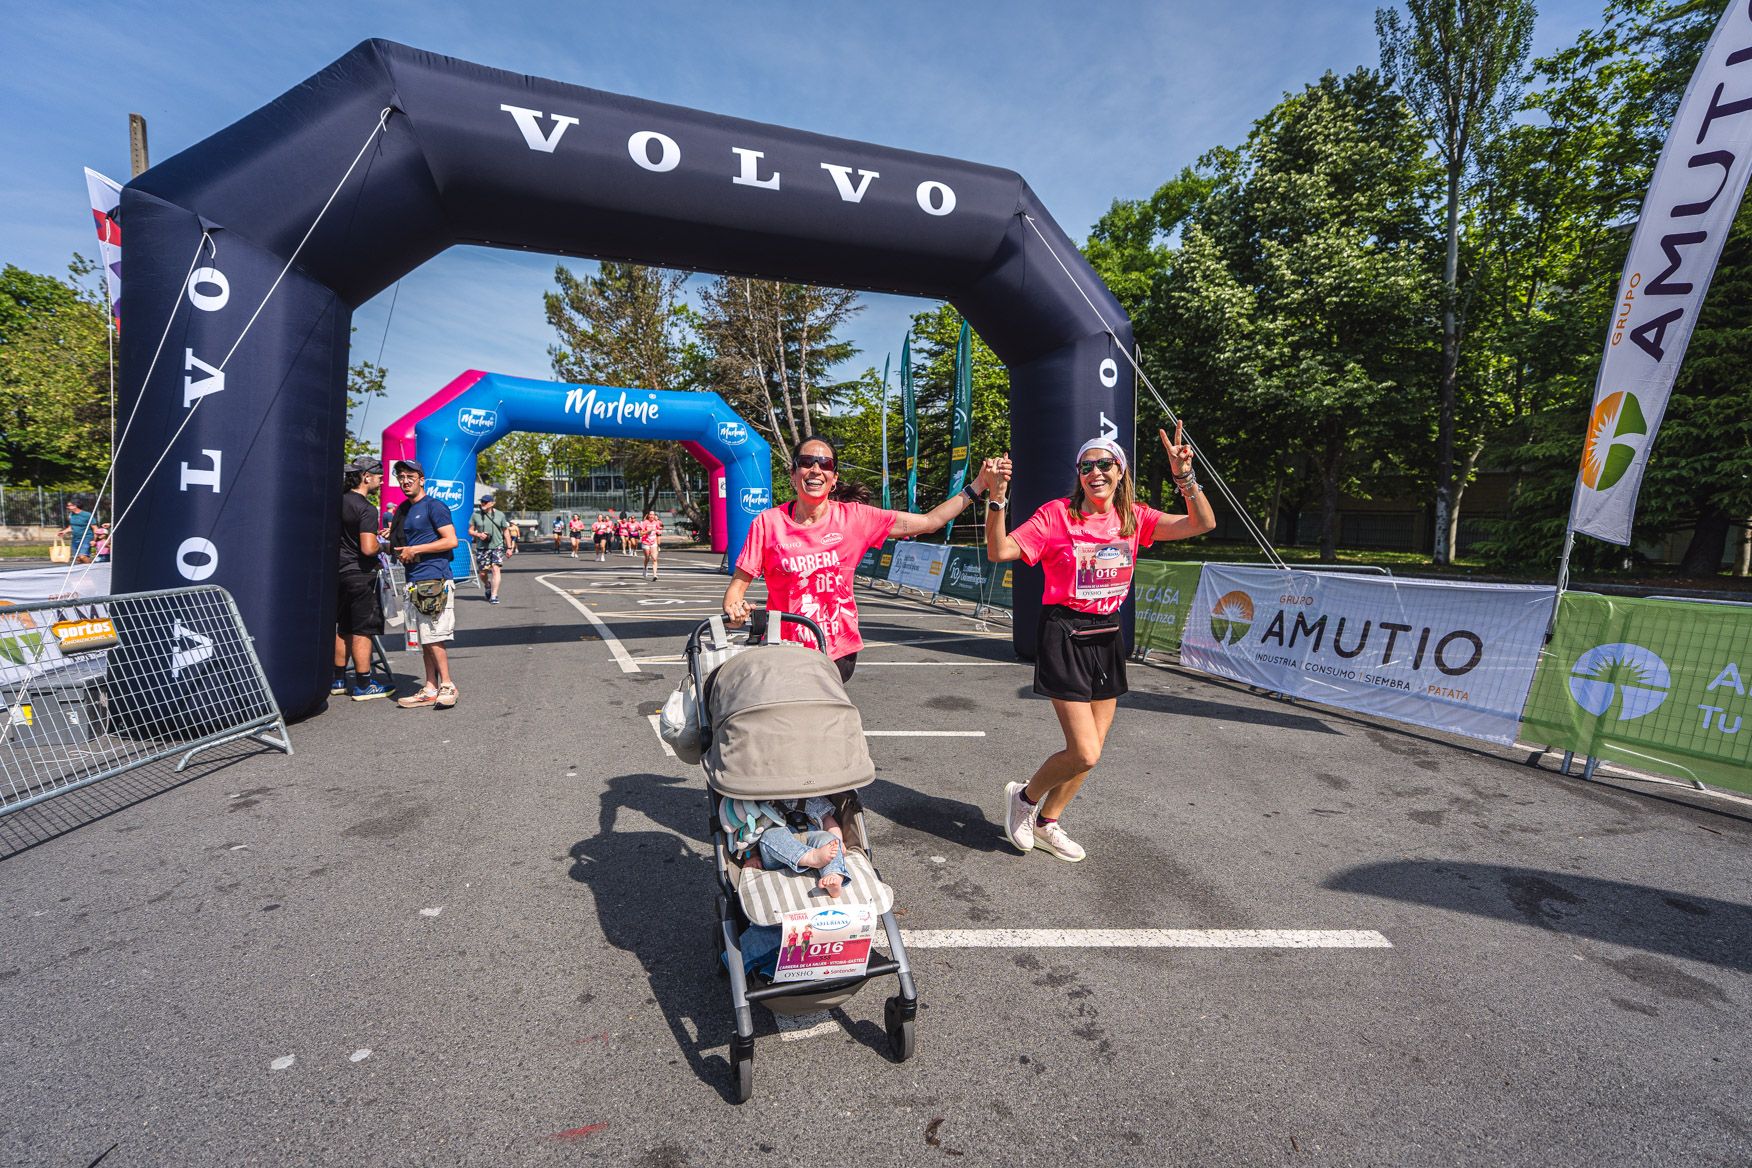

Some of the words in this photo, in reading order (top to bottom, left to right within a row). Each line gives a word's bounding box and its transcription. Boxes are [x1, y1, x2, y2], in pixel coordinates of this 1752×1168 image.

[500, 103, 957, 216] VOLVO
[1611, 272, 1641, 346] GRUPO
[461, 413, 494, 428] Marlene
[565, 388, 659, 429] Marlene
[171, 267, 230, 678] VOLVO
[781, 550, 839, 573] CARRERA
[1096, 569, 1118, 578] 016
[1146, 587, 1179, 605] CASA
[1279, 594, 1313, 606] GRUPO
[1261, 610, 1483, 676] AMUTIO
[1255, 653, 1296, 668] INDUSTRIA
[1305, 662, 1355, 680] CONSUMO
[1364, 674, 1410, 691] SIEMBRA
[1428, 684, 1469, 701] PATATA
[1707, 662, 1752, 697] A
[809, 941, 844, 955] 016
[784, 970, 813, 978] OYSHO
